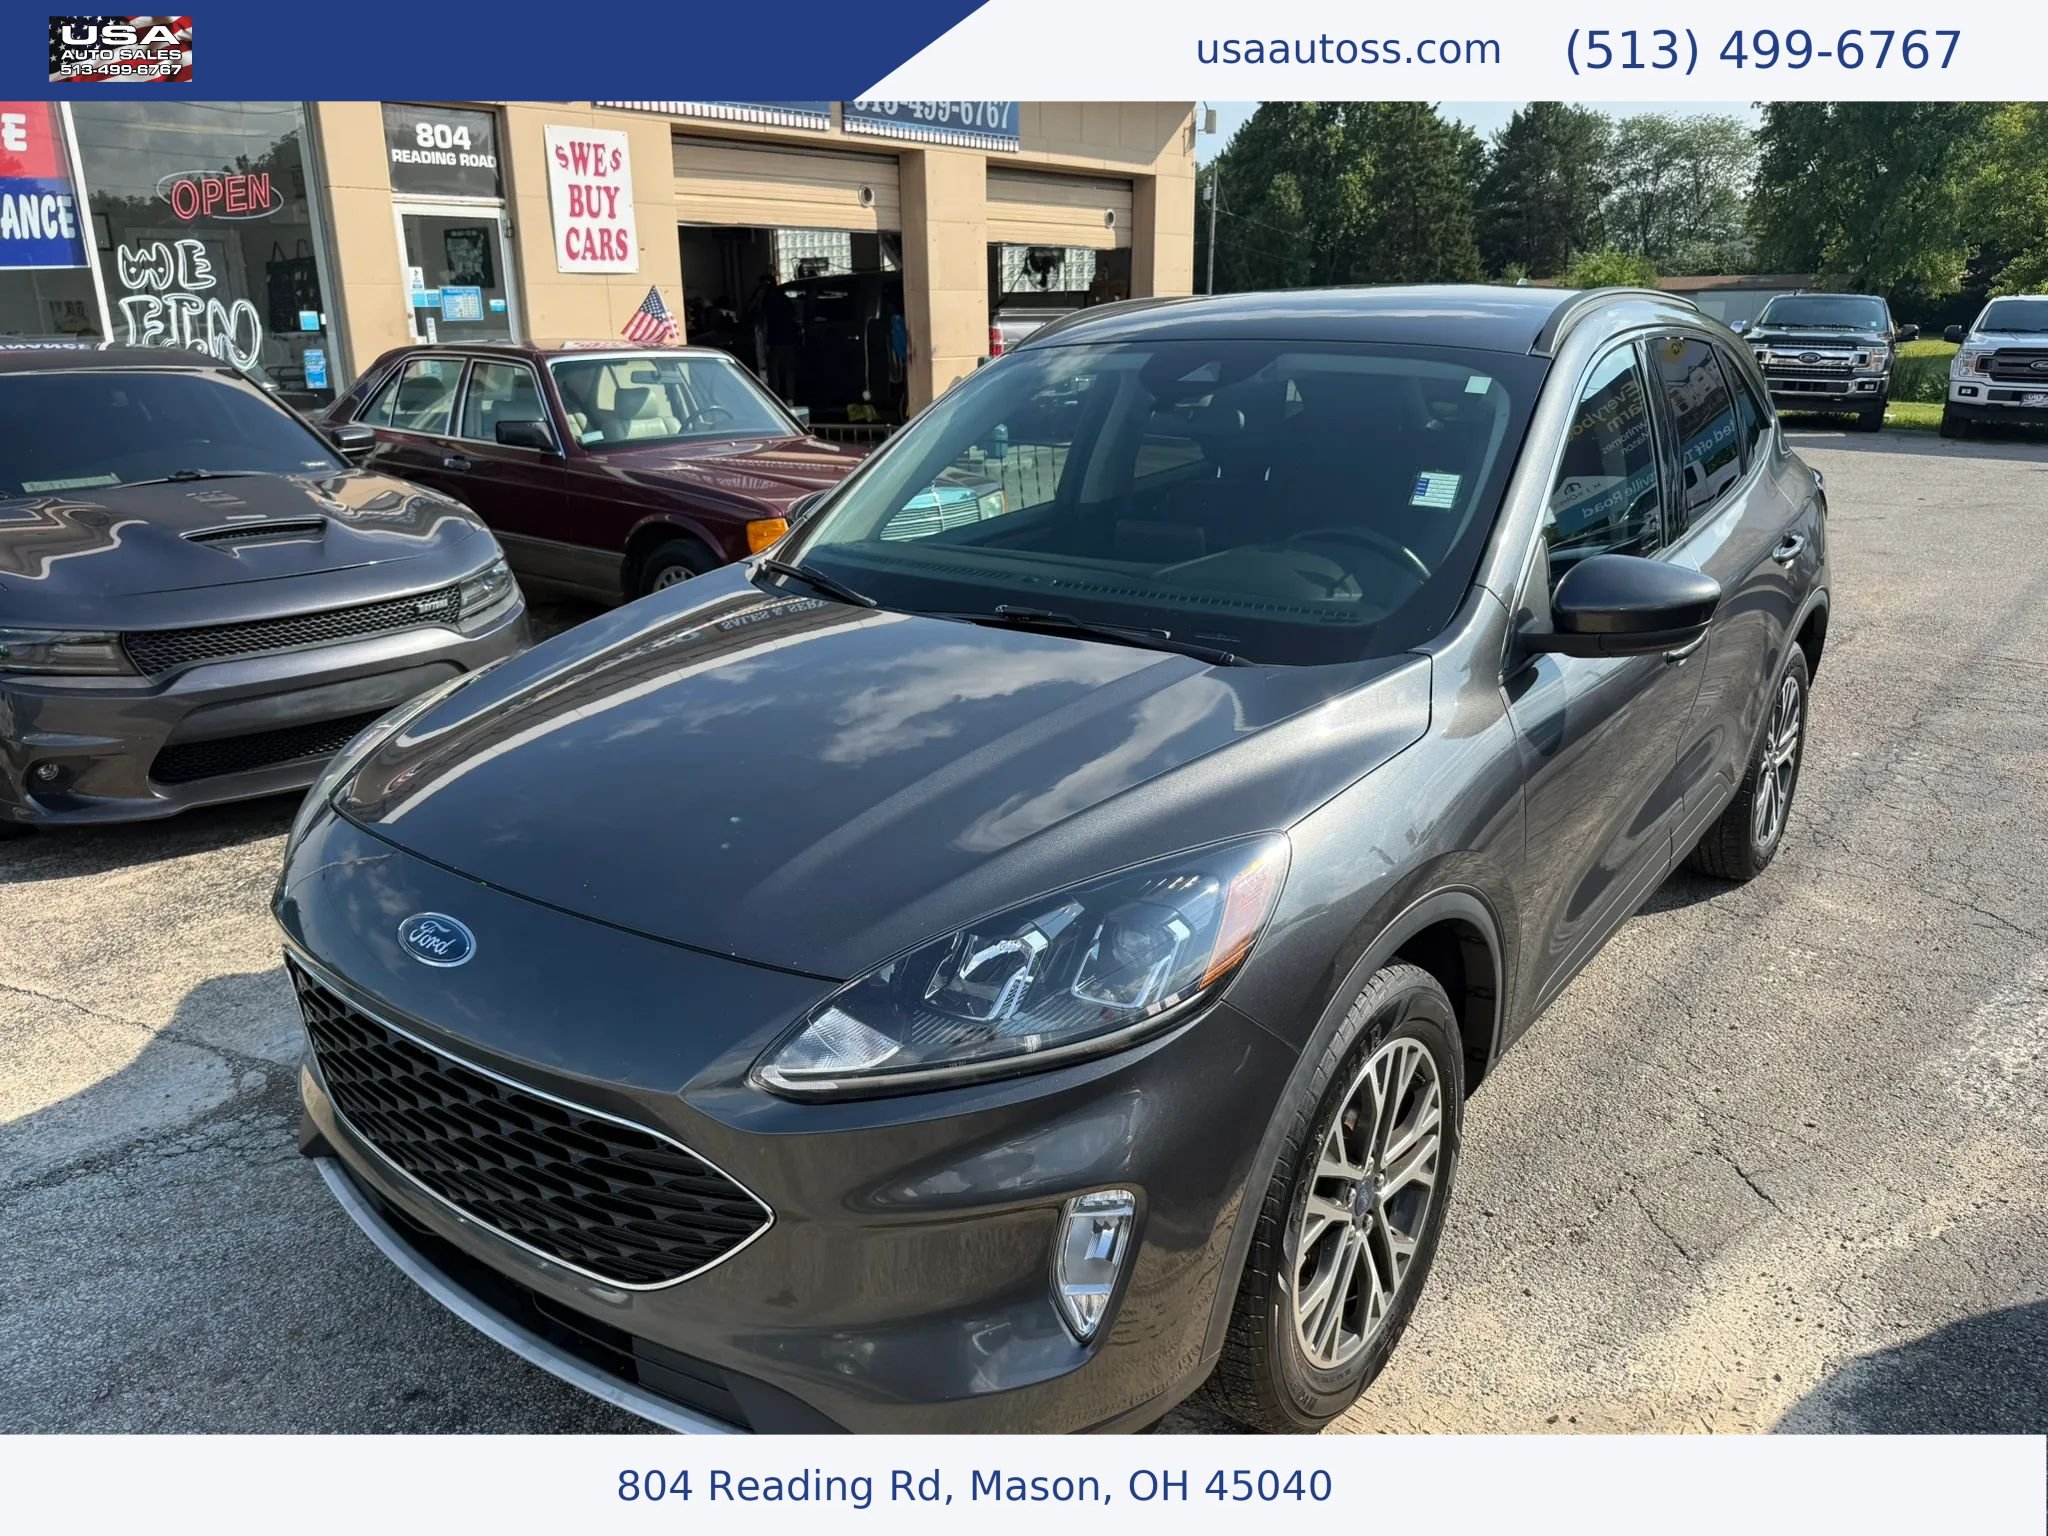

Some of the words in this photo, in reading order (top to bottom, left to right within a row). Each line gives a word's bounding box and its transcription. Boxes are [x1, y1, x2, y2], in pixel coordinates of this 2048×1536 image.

[415, 123, 471, 150] 804
[391, 148, 457, 167] READING
[460, 153, 497, 169] ROAD
[171, 173, 270, 220] OPEN
[568, 184, 620, 219] BUY
[565, 227, 629, 261] CARS
[118, 239, 216, 290] WE
[408, 920, 457, 955] Ford
